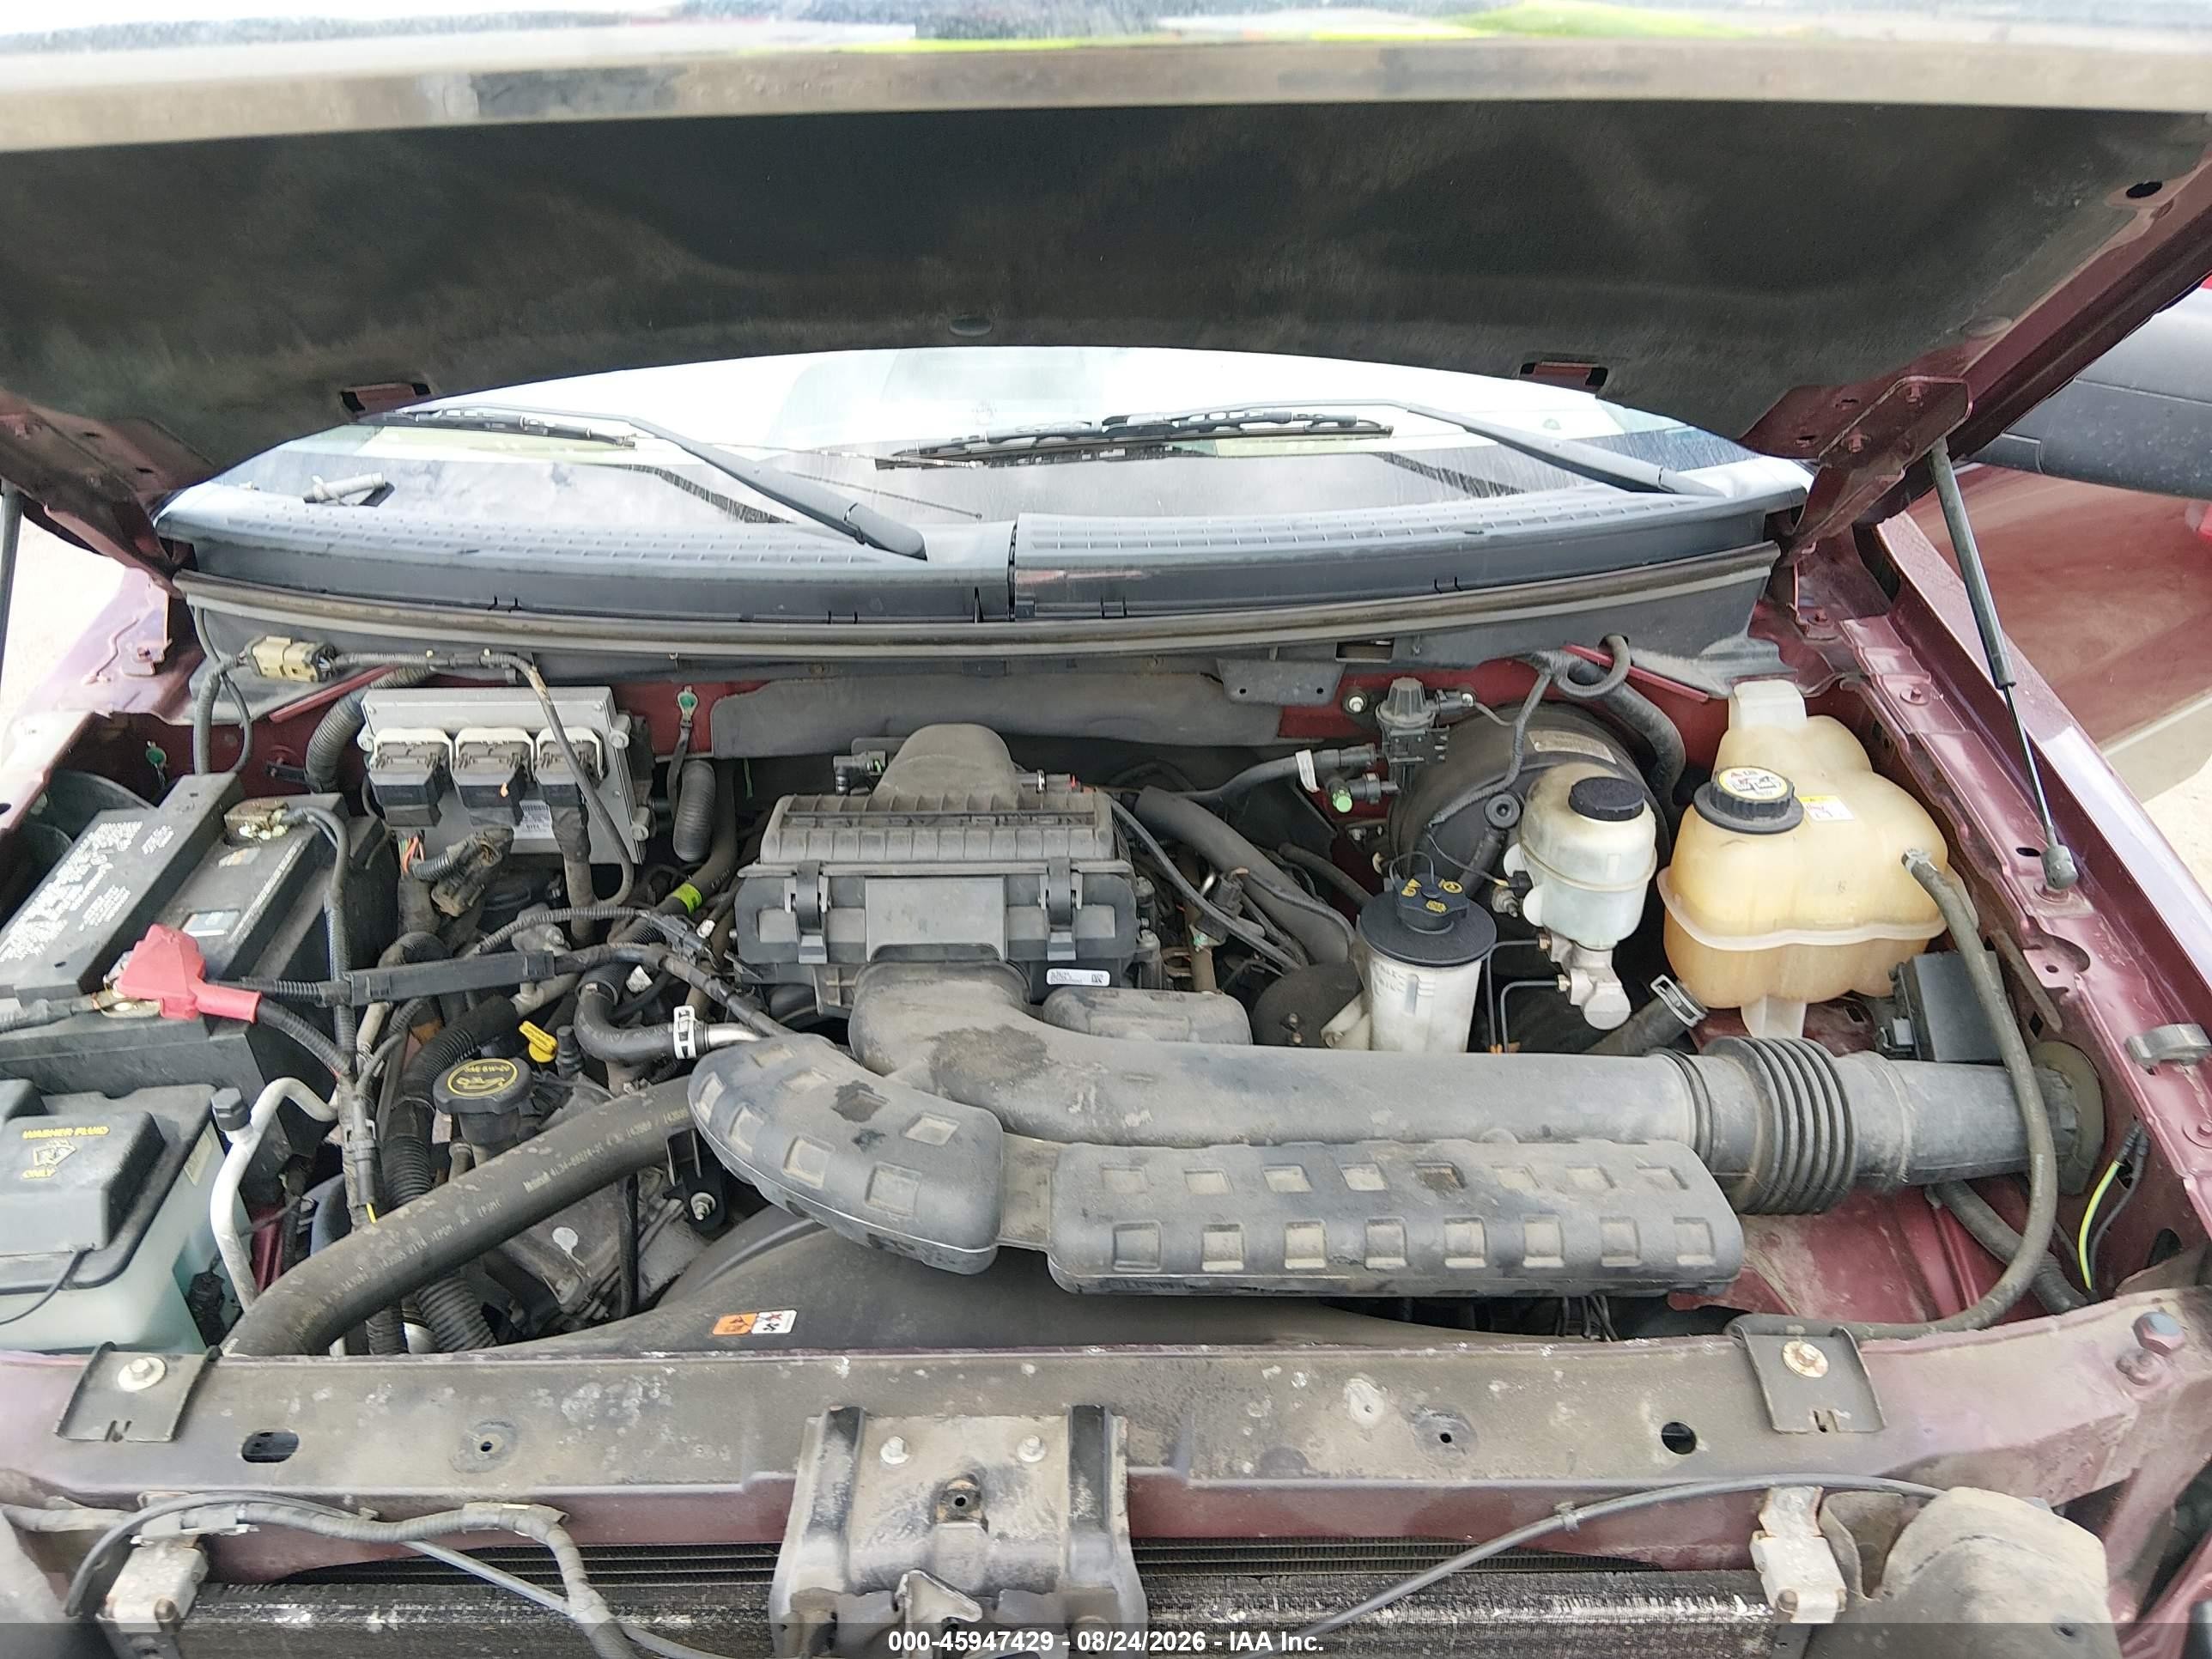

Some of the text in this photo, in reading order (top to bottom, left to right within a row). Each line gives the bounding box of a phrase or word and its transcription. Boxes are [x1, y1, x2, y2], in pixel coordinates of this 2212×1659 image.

[22, 1126, 110, 1139] WASHER FLUID
[22, 1167, 56, 1178] ONLY
